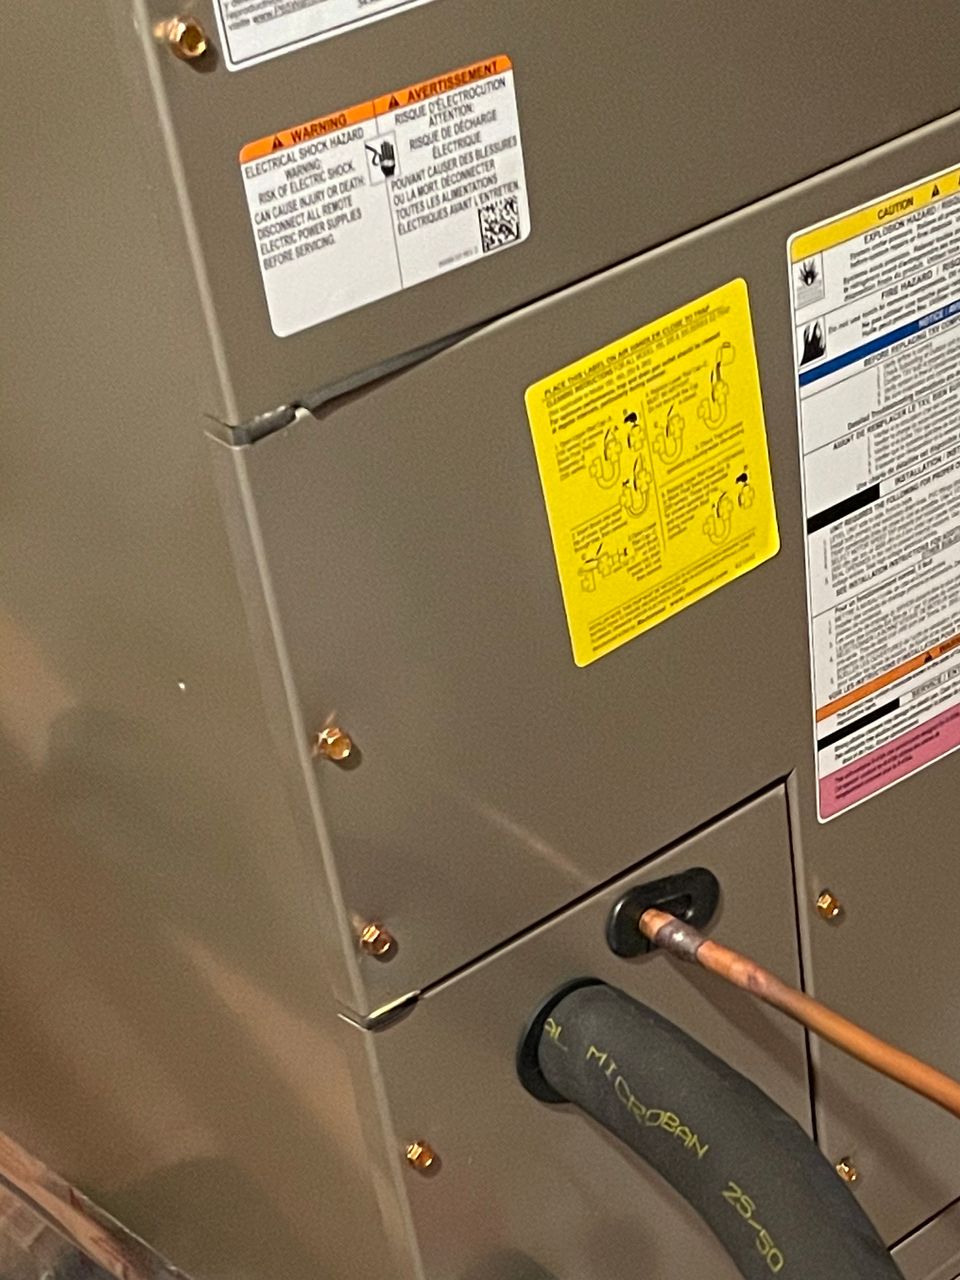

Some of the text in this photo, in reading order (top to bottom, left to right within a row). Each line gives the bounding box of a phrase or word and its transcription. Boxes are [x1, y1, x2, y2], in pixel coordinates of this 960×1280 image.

[406, 61, 498, 103] AVERTISSEMENT
[290, 113, 347, 144] WARNING
[245, 127, 364, 179] ELECTRICAL SHOCK HAZARD
[254, 209, 271, 226] CAN
[272, 200, 298, 219] CAUSE
[300, 189, 326, 209] INJURY
[327, 185, 339, 199] OR
[258, 188, 277, 205] RISK
[278, 184, 289, 198] OF
[290, 171, 327, 194] ELECTRIC
[878, 196, 913, 221] CAUTION
[257, 195, 353, 240] DISCONNECT ALL REMOTE
[260, 208, 362, 256] ELECTRIC POWER SUPPLIES
[263, 249, 294, 271] BEFORE
[901, 270, 932, 292] HAZARD
[586, 1044, 708, 1160] MICROBAN
